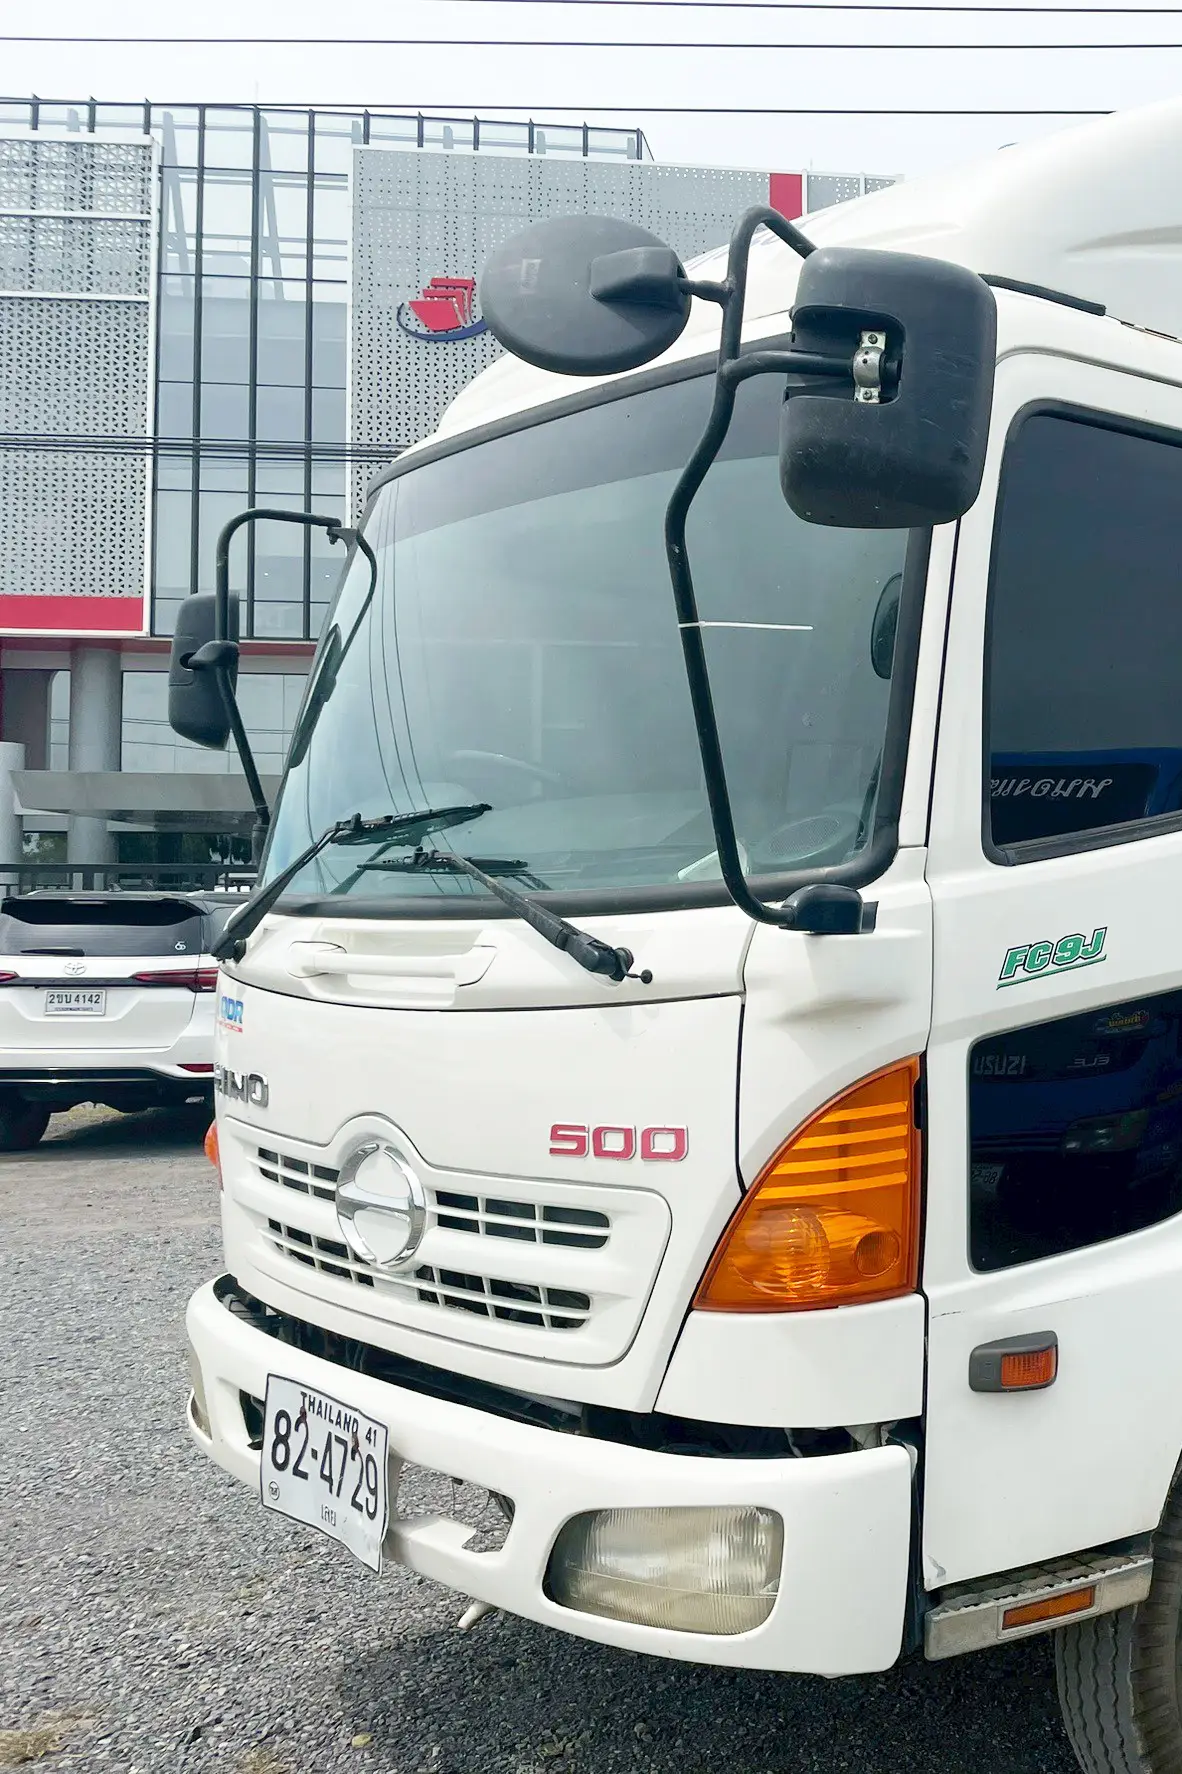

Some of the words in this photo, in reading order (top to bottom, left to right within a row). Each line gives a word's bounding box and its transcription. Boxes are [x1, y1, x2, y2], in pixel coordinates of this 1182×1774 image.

[74, 993, 101, 1005] 4142
[548, 1121, 690, 1162] 500
[300, 1391, 359, 1434] THAILAND
[365, 1428, 378, 1448] 41
[271, 1409, 379, 1521] 82-4729
